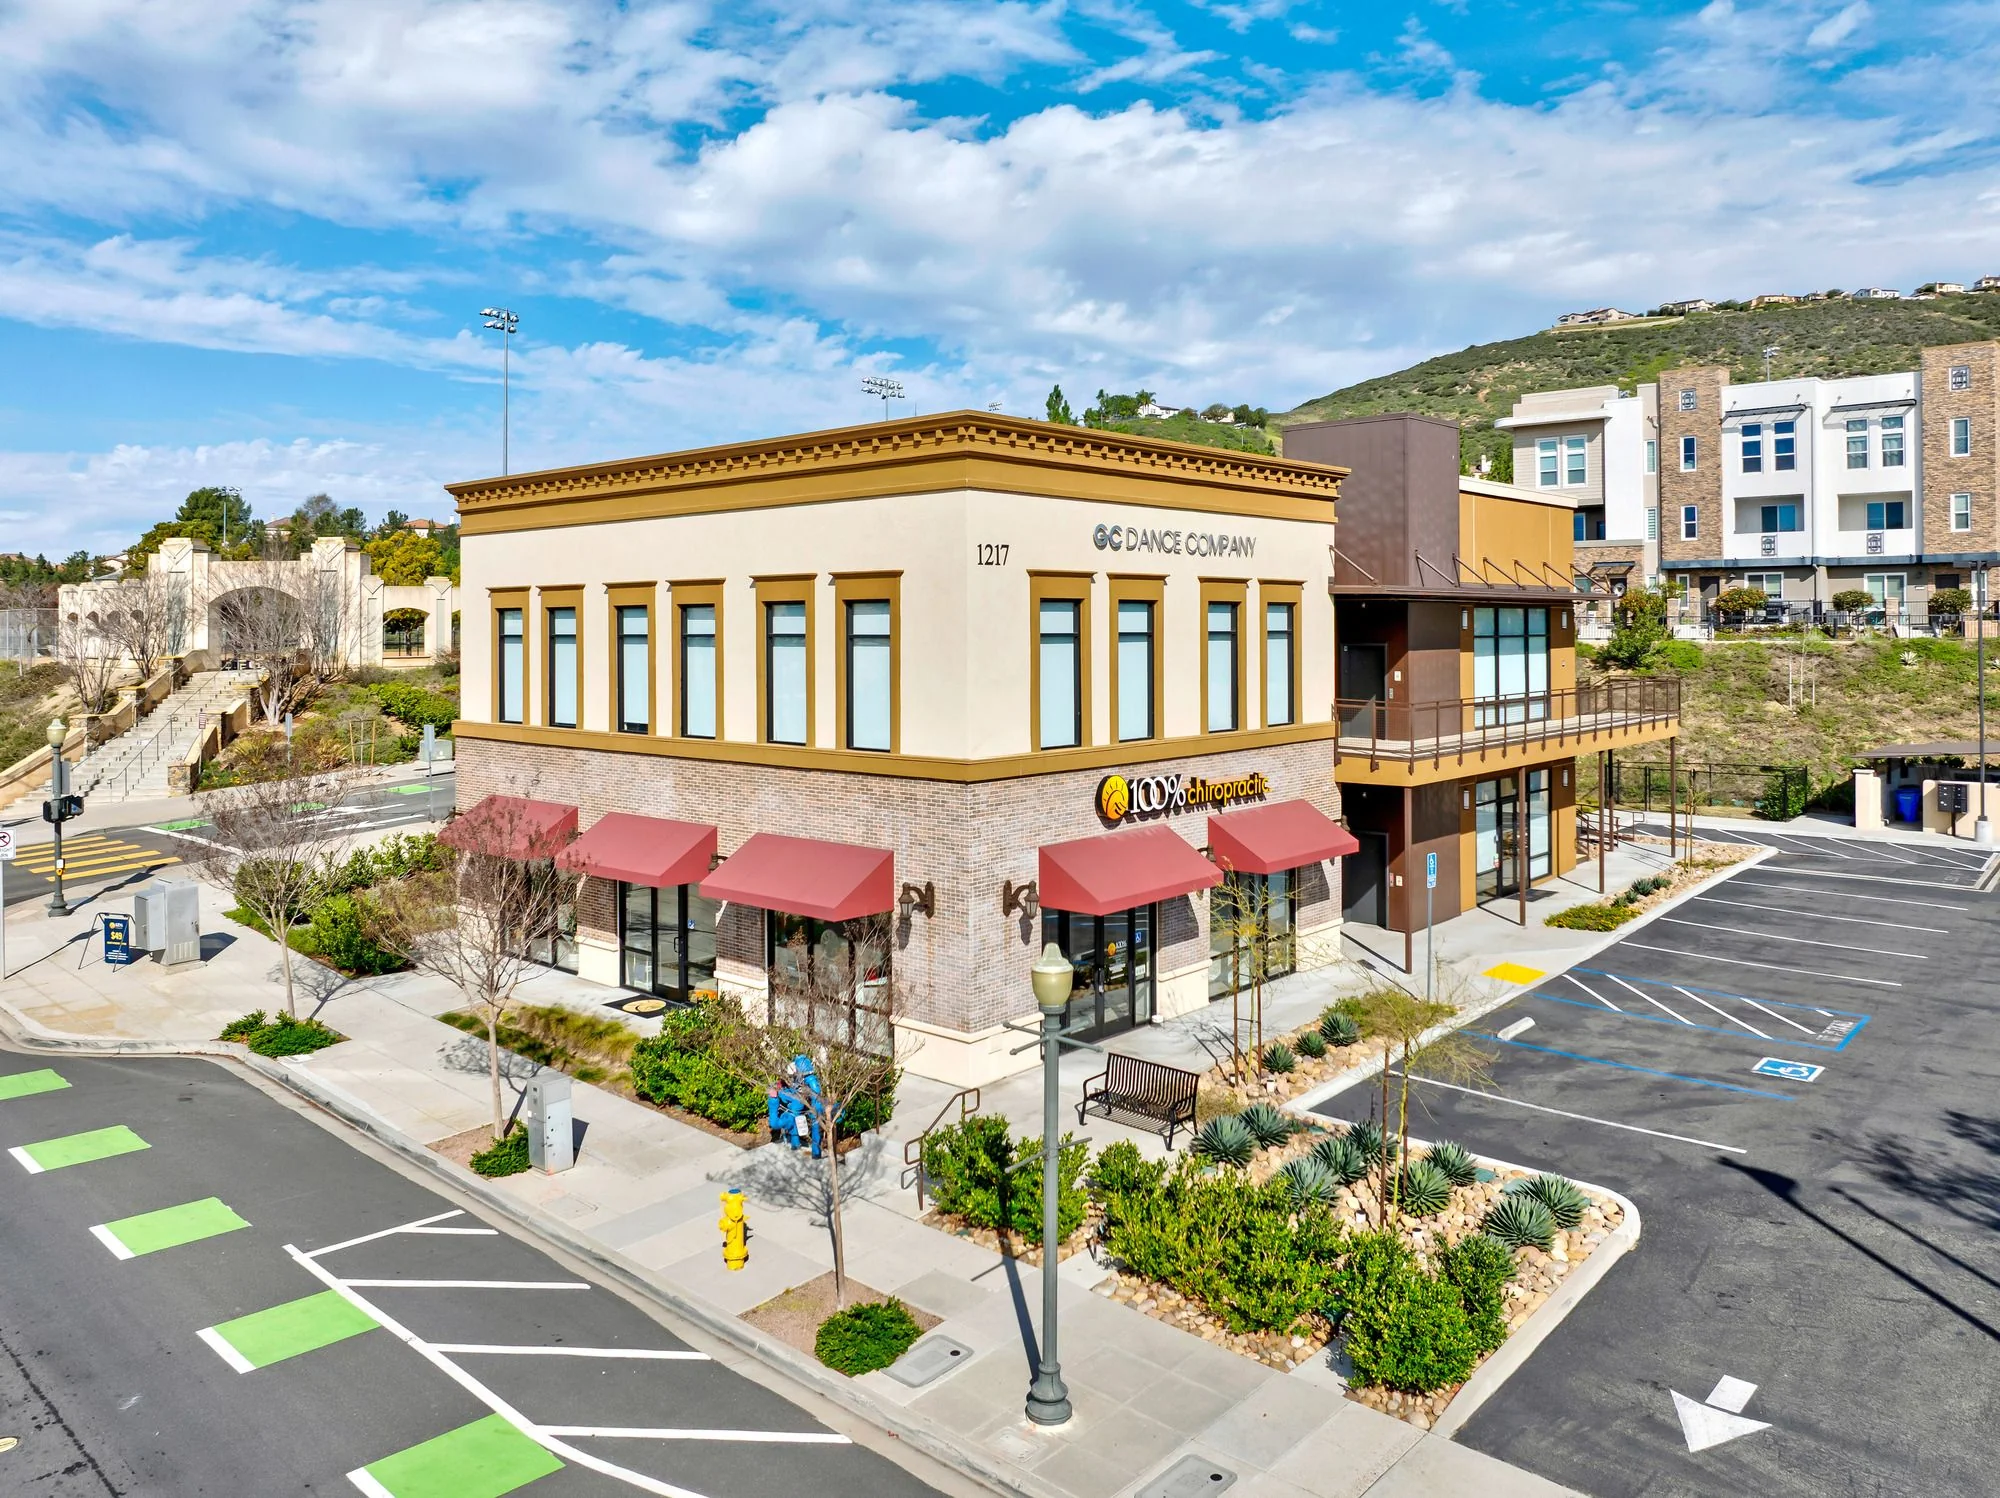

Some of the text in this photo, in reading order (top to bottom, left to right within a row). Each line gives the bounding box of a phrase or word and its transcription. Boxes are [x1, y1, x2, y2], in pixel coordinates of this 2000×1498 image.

[976, 543, 1010, 566] 1217
[1125, 527, 1182, 555] DANCE
[1185, 530, 1256, 558] COMPANY
[1129, 774, 1186, 814] 100%
